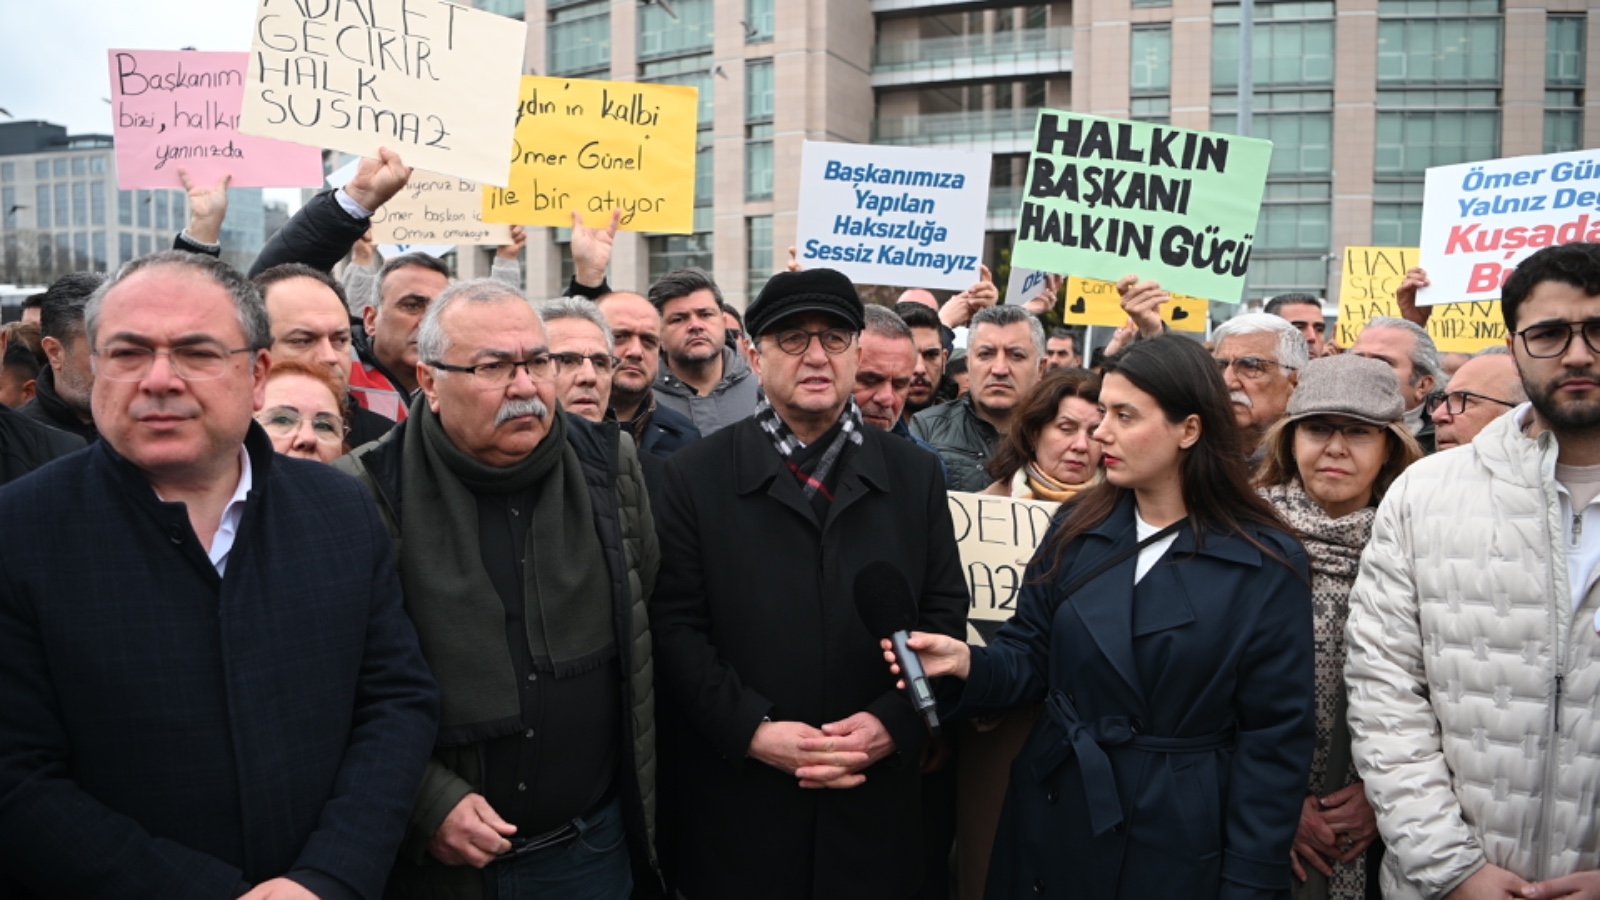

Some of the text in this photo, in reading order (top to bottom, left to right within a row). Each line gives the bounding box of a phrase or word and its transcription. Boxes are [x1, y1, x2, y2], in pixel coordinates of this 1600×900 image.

[116, 52, 242, 96] Başkanım
[257, 51, 381, 102] HALK
[119, 108, 166, 134] bizi,
[261, 89, 451, 150] SUSMAZ
[601, 88, 661, 126] kalbi
[155, 140, 244, 170] yanınızda
[577, 141, 643, 171] Günel
[1035, 114, 1229, 173] HALKIN
[824, 160, 965, 189] Başkanımıza
[1029, 158, 1192, 216] BAŞKANI
[1462, 166, 1546, 191] Ömer
[491, 178, 666, 225] ile bir atıyor
[855, 190, 935, 215] Yapılan
[1458, 188, 1600, 217] Yalnız De
[833, 216, 948, 247] Haksızlığa
[1018, 202, 1255, 278] HALKIN GÜCÜ
[803, 240, 977, 273] Sessiz Kalmayız
[1349, 277, 1396, 300] SEÇ
